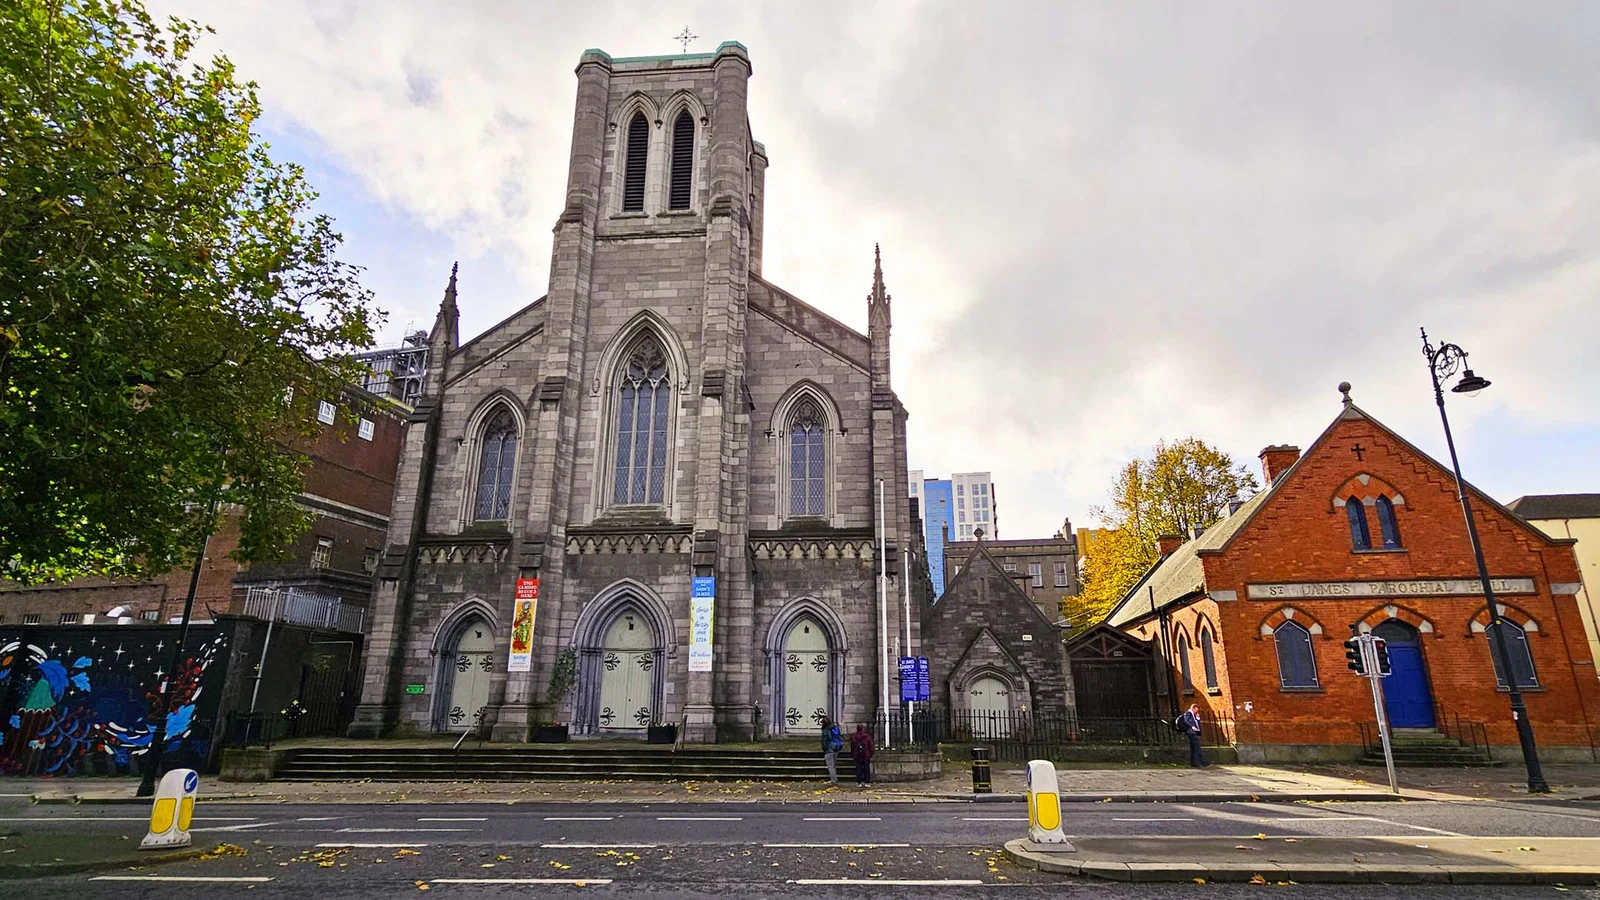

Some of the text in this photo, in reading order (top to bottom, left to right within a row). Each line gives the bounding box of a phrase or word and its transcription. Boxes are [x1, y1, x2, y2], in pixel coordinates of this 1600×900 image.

[1303, 584, 1352, 596] JAMES
[1368, 582, 1453, 595] PAROCHIAL
[1469, 580, 1517, 592] HLL.
